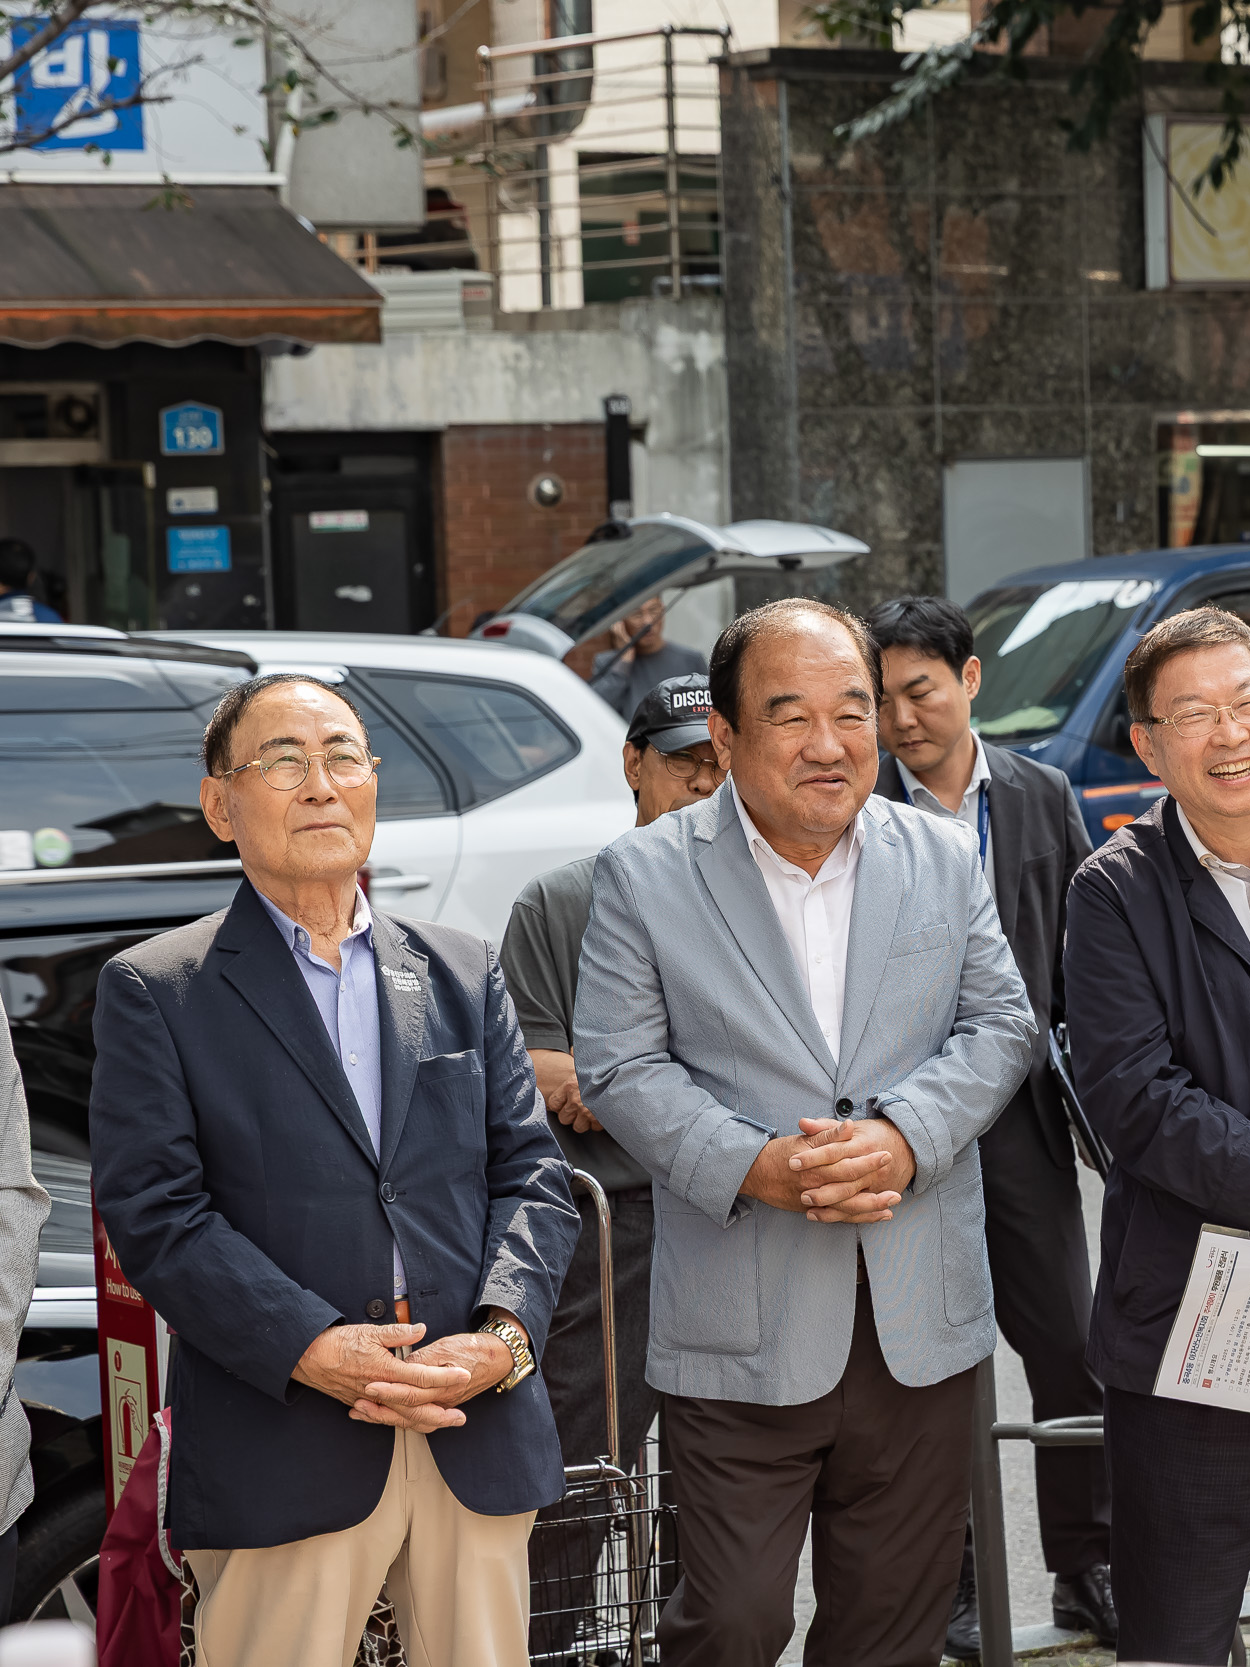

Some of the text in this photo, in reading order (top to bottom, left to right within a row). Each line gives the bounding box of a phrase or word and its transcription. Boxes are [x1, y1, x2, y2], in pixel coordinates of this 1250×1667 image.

[105, 1277, 142, 1301] How to use
